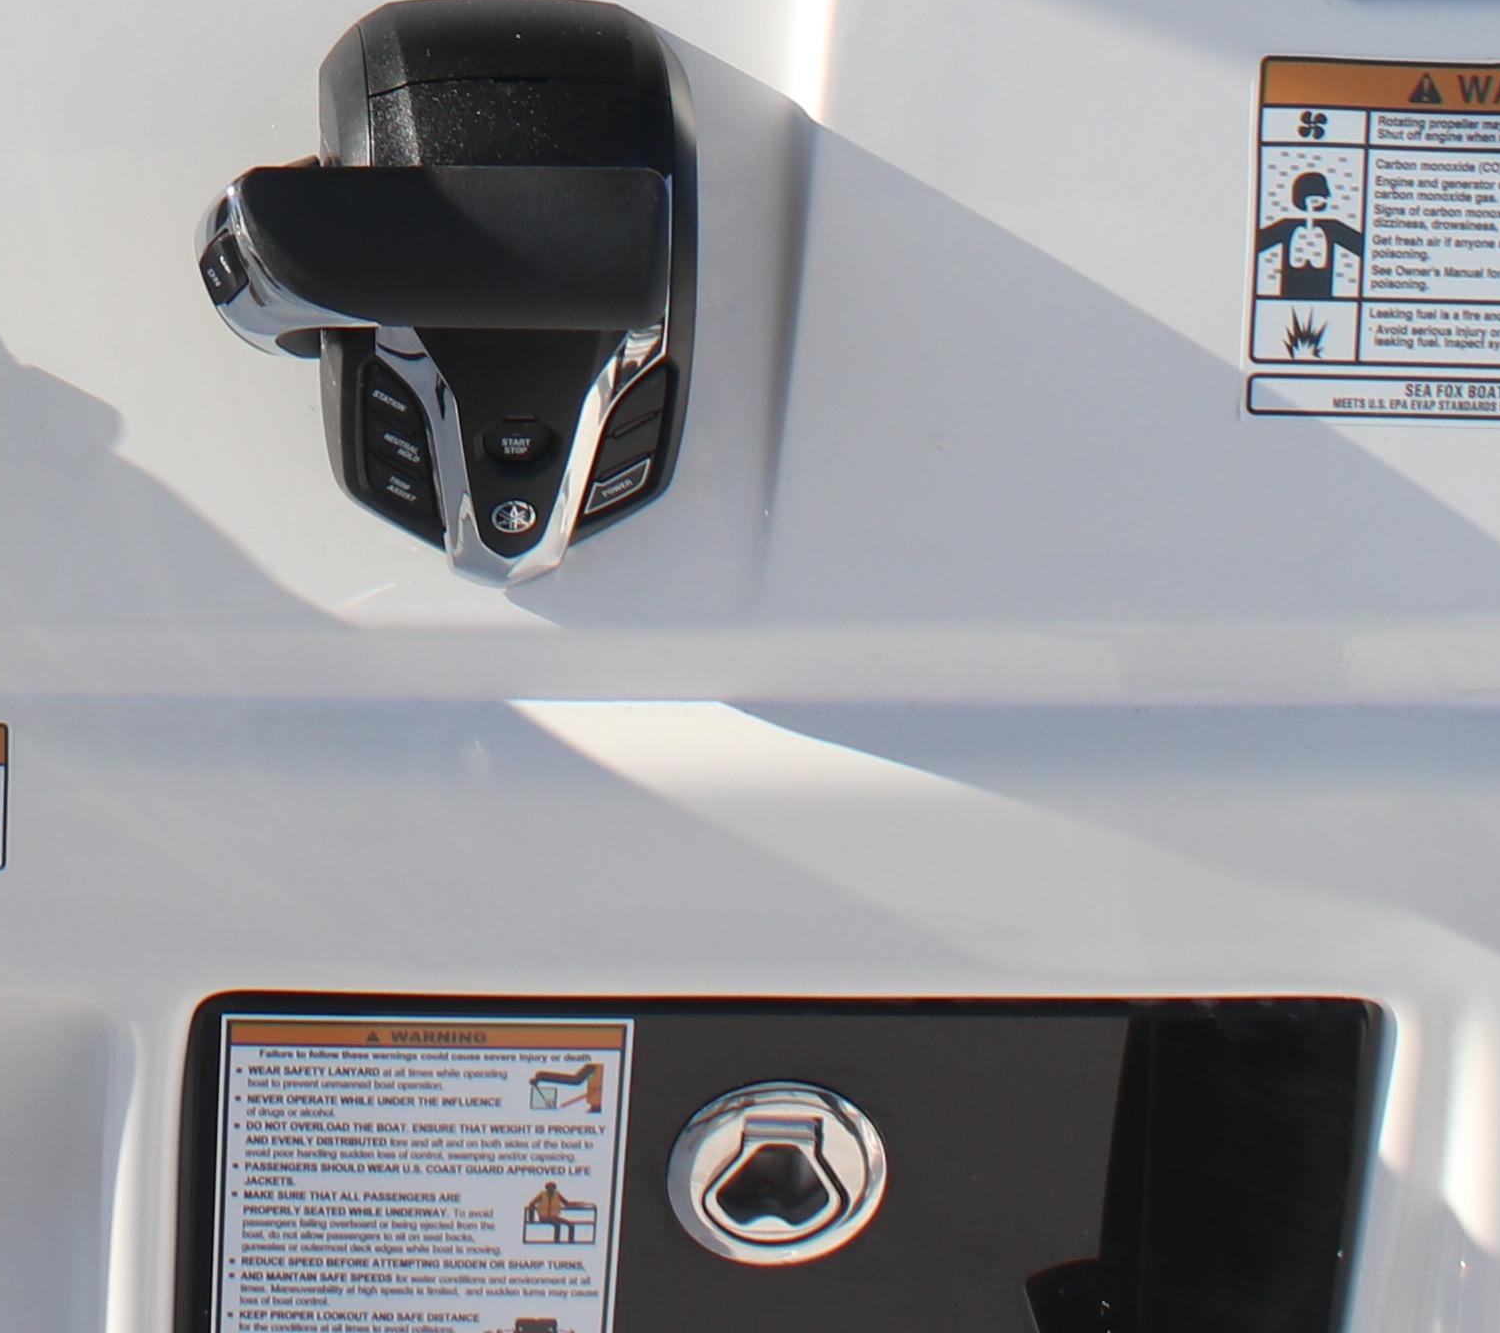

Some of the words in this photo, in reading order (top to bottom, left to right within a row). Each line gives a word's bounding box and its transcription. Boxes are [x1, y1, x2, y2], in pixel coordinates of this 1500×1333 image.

[1378, 116, 1426, 132] Rotating
[1428, 118, 1480, 134] propeller
[1376, 158, 1417, 170] Carbon
[1420, 162, 1476, 172] monoxide
[1405, 383, 1432, 397] SEA
[1436, 383, 1463, 398] FOX
[1332, 397, 1365, 412] MEETS
[1367, 398, 1386, 413] U.S.
[1388, 399, 1408, 413] EPA
[1410, 399, 1436, 414] EVAP
[1437, 399, 1497, 412] STANDARDS
[502, 438, 530, 446] START
[603, 479, 633, 497] POWER
[390, 1031, 486, 1043] WARNING
[247, 1094, 284, 1104] NEVER
[286, 1094, 337, 1105] OPERATE
[339, 1095, 374, 1106] WHILE
[377, 1096, 415, 1106] UNDER
[418, 1096, 438, 1106] THE
[441, 1097, 500, 1107] INFLUENCE
